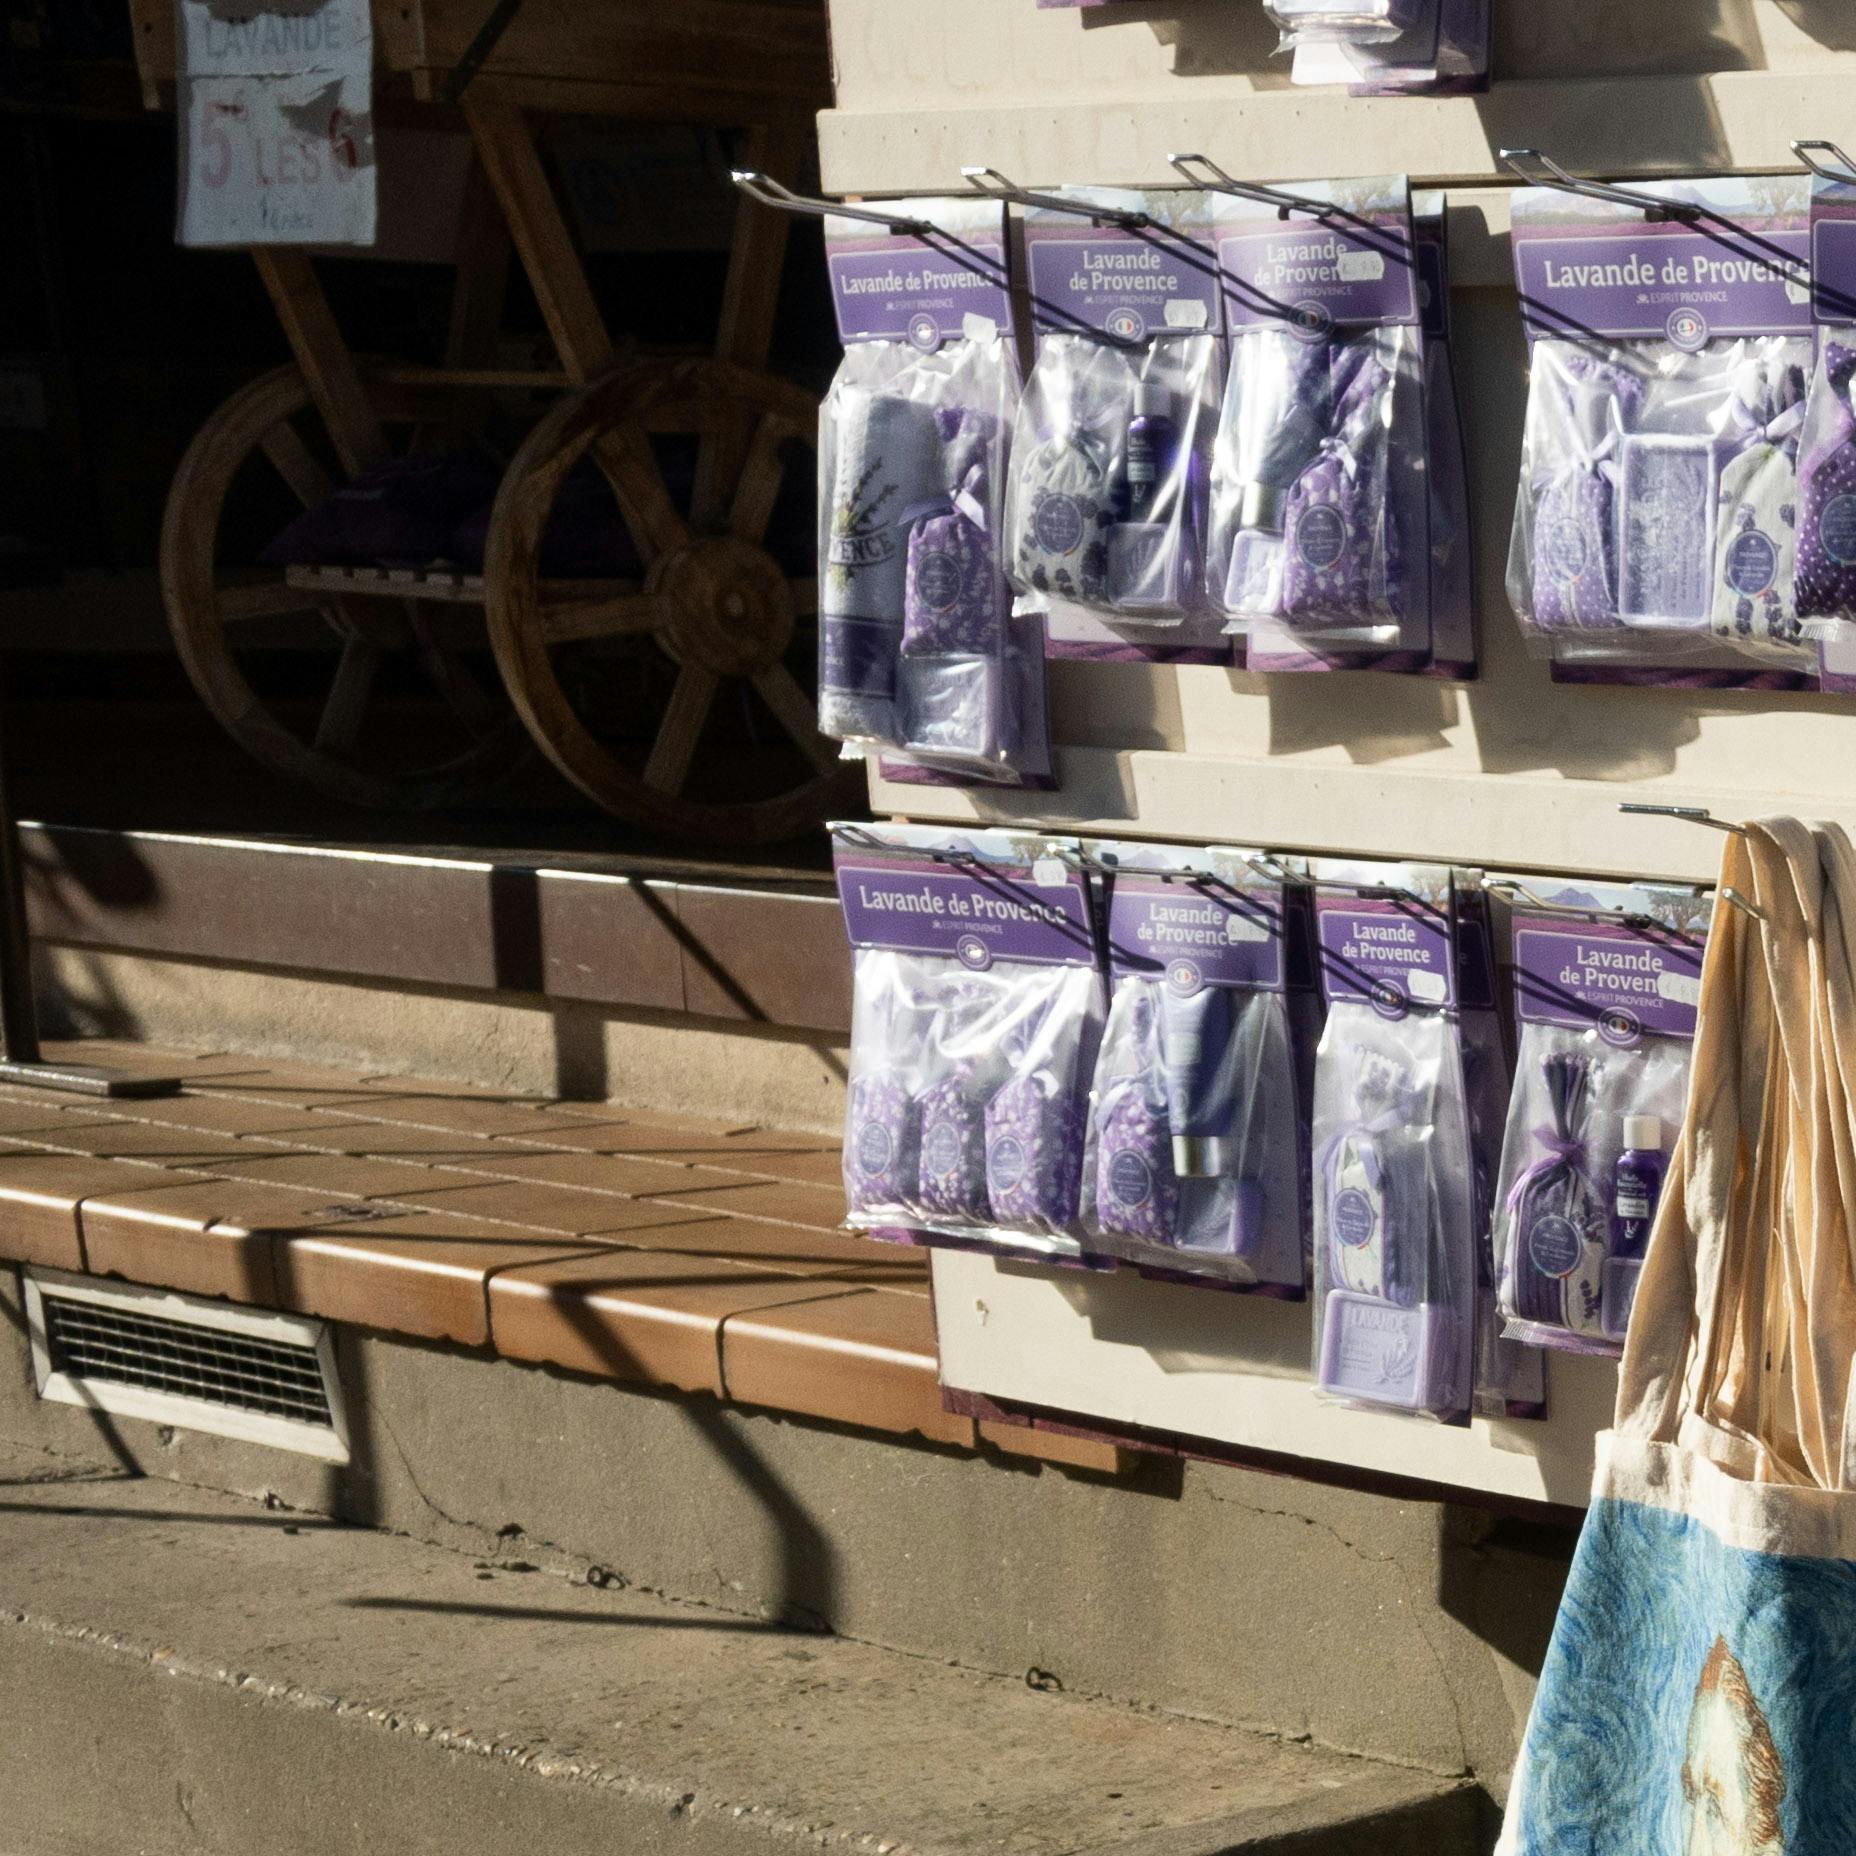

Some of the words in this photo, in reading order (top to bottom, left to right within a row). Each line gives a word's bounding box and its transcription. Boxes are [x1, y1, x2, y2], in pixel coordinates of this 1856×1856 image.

[1083, 248, 1161, 270] Lavande
[1266, 237, 1348, 264] Lavande
[1069, 272, 1088, 291] de
[1092, 272, 1178, 291] Provence
[1254, 269, 1271, 287] de
[1274, 264, 1341, 284] Prove
[1544, 253, 1655, 288] Lavande
[1661, 257, 1688, 285] de
[1692, 255, 1810, 285] Provenc
[841, 270, 902, 295] Lavande
[905, 270, 922, 291] de
[859, 885, 945, 915] Lavande
[949, 893, 970, 917] de
[1150, 903, 1223, 925] Lavande
[1137, 922, 1153, 940] de
[1352, 922, 1416, 943] Lavande
[1342, 941, 1359, 958] de
[1360, 942, 1431, 963] Provence
[1577, 945, 1663, 973] Lavande
[1560, 966, 1580, 985] de
[1585, 968, 1658, 994] Proven
